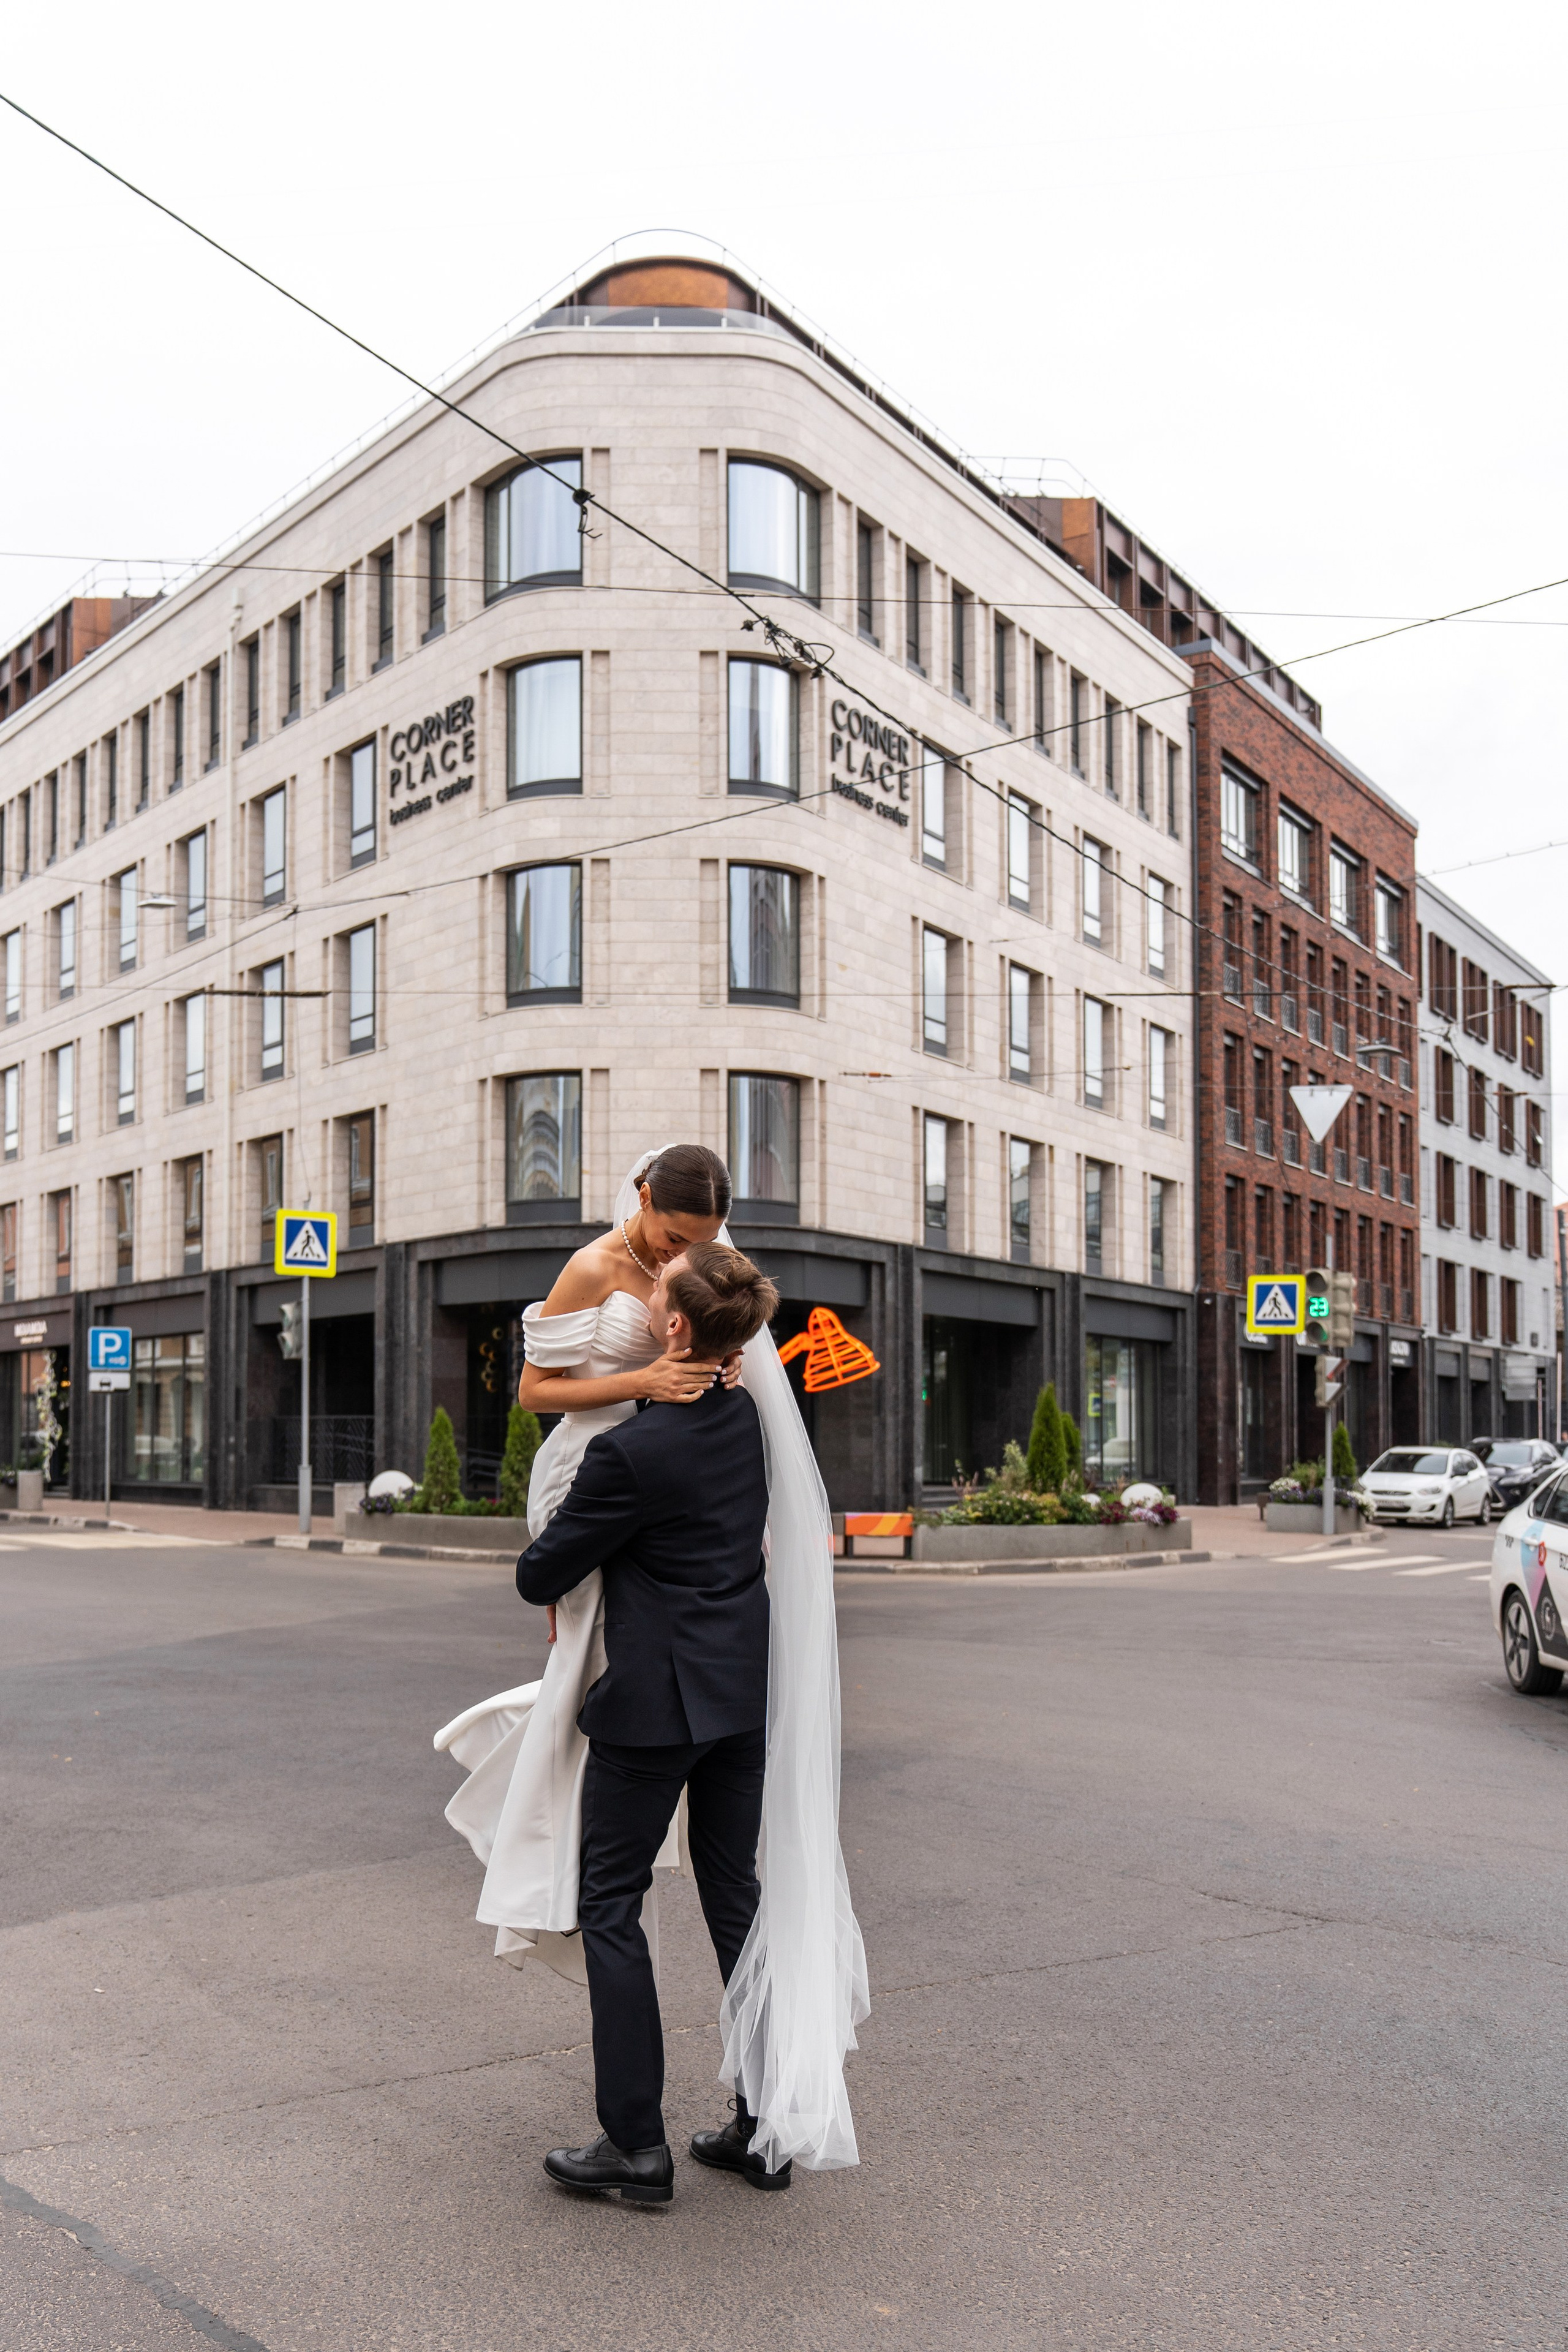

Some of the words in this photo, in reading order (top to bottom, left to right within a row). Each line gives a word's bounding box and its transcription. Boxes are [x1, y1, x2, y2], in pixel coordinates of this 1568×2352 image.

[390, 695, 474, 762] CORNER
[832, 699, 908, 766] CORNER
[390, 729, 475, 798] PLACE
[831, 733, 910, 801] PLACE
[876, 802, 909, 827] center
[1309, 1297, 1329, 1317] 23
[99, 1332, 123, 1366] P
